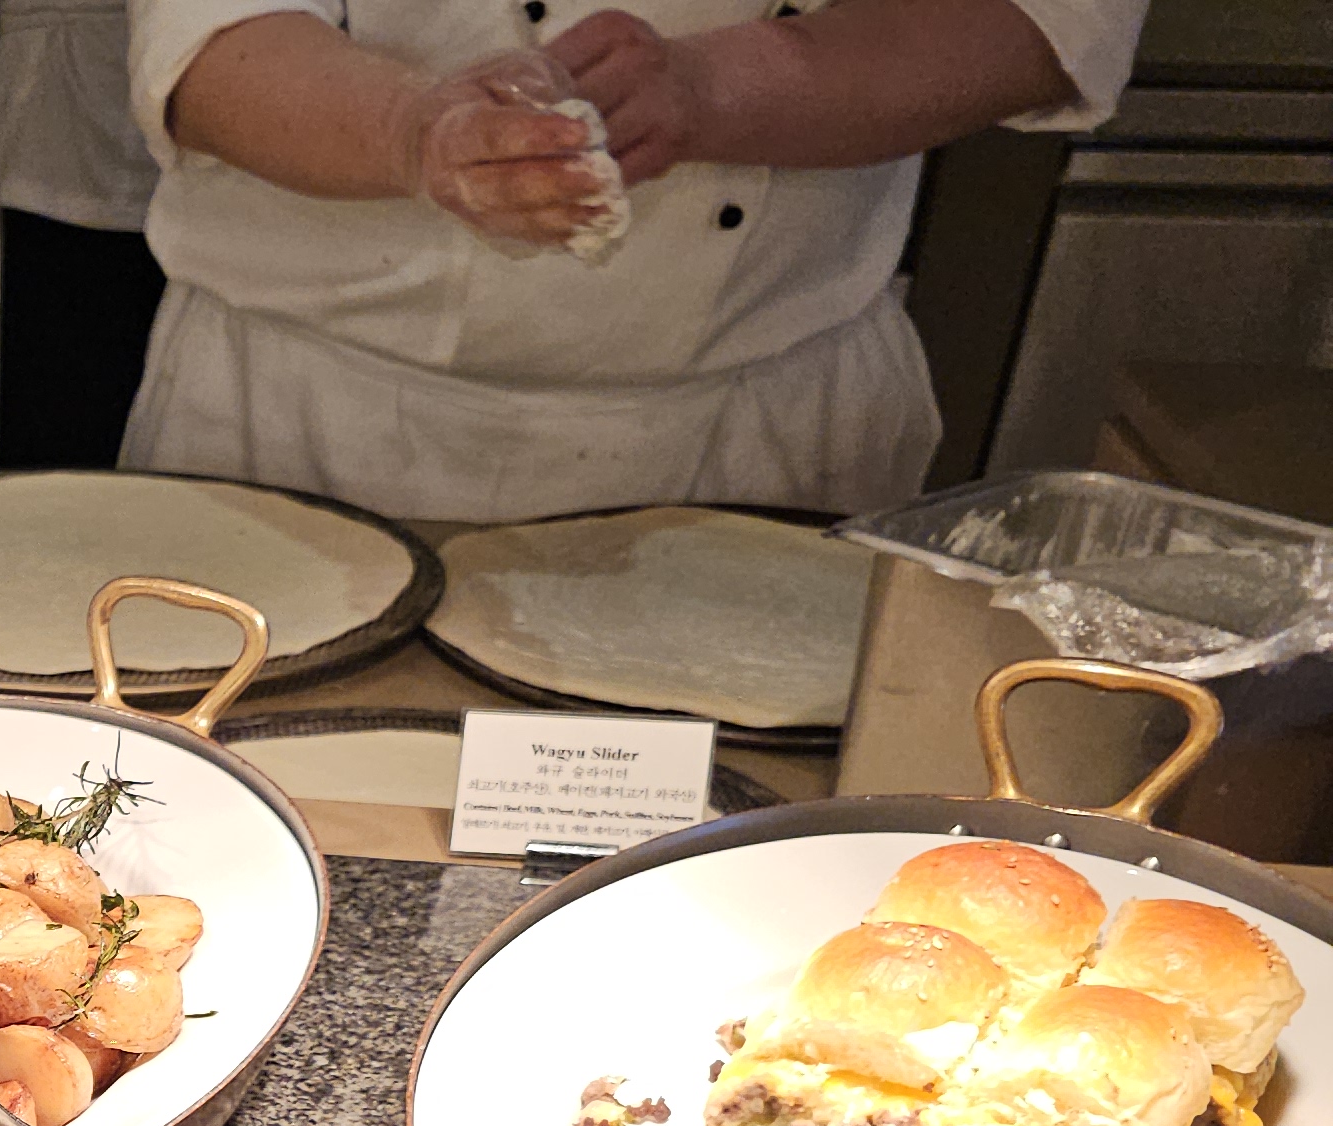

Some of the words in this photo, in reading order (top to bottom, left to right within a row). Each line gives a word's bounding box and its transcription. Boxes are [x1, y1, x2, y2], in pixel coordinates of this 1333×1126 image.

[531, 743, 586, 762] Wagyu
[590, 747, 640, 763] Slider
[536, 764, 564, 777] 와규
[571, 765, 629, 781] 슬라이더
